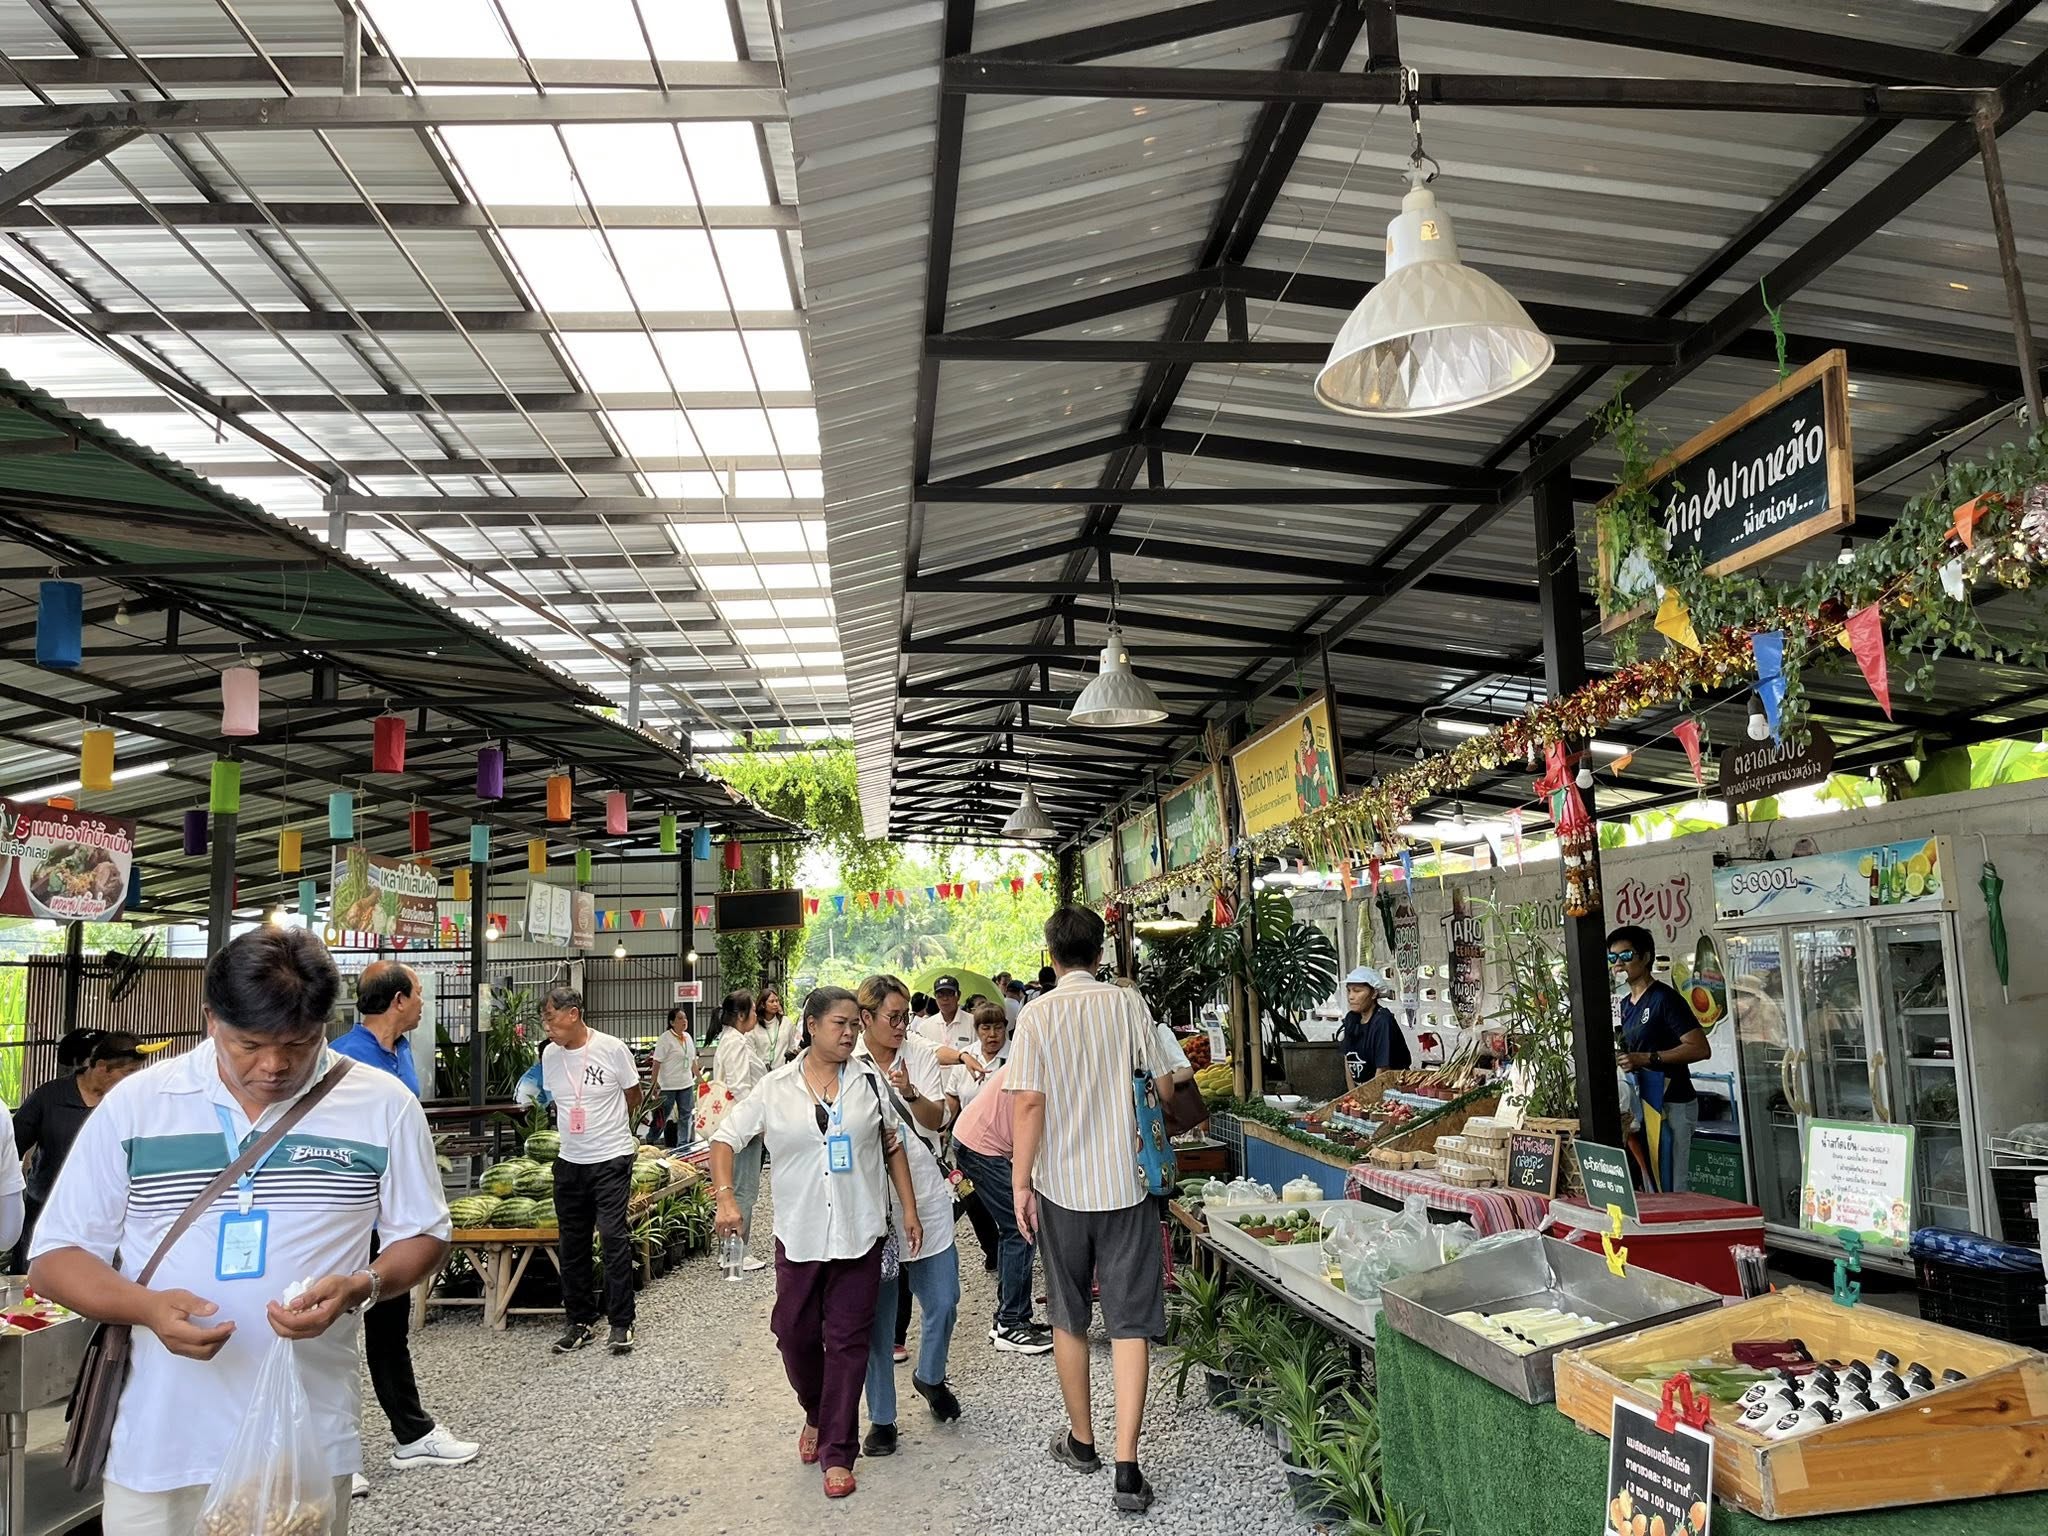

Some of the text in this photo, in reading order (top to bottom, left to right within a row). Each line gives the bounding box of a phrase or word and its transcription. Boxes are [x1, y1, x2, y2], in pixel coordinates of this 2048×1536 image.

[1731, 867, 1799, 905] S-COOL
[1440, 914, 1484, 954] TARO
[292, 1144, 353, 1164] EAGLES
[1662, 1476, 1672, 1490] 35
[1650, 1493, 1665, 1509] 100
